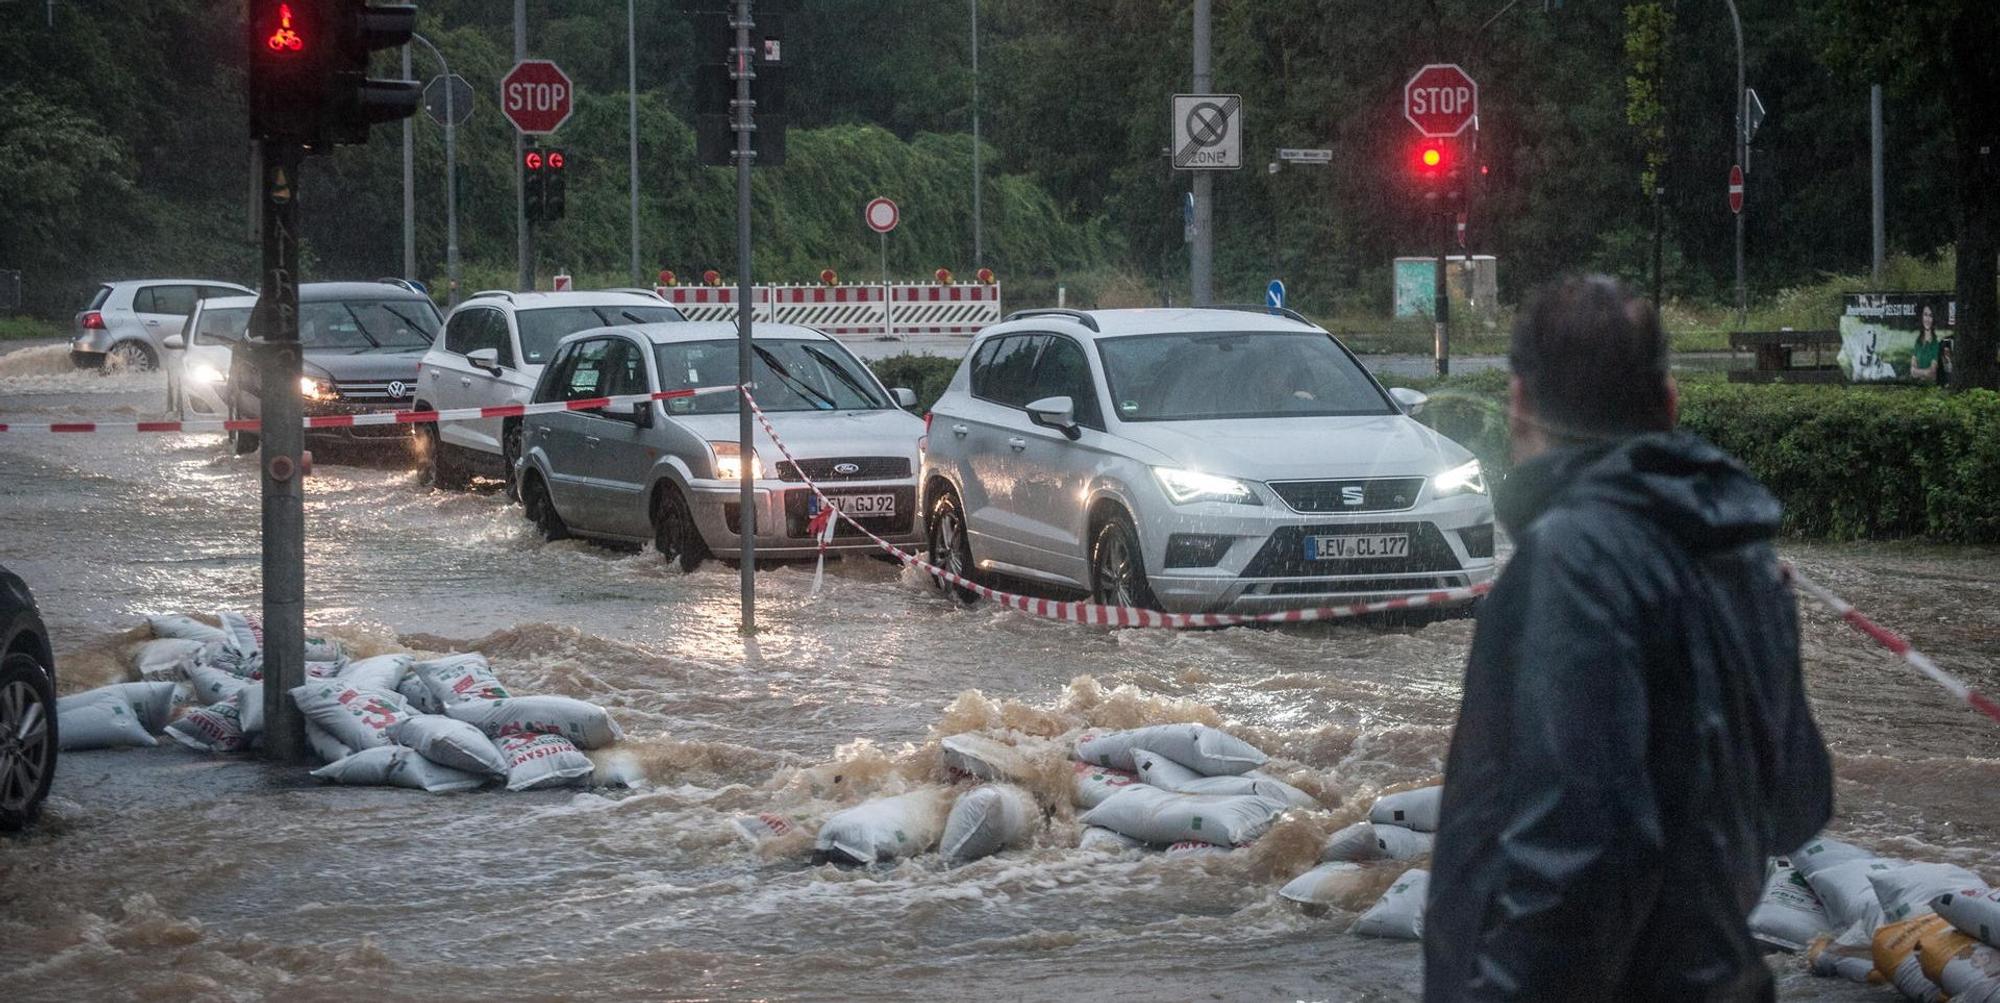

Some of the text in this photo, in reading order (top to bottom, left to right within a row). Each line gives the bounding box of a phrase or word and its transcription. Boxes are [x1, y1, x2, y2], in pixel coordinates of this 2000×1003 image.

[508, 82, 566, 112] STOP
[1413, 87, 1470, 114] STOP
[1191, 150, 1226, 164] ZONE
[855, 496, 874, 511] GJ
[876, 495, 893, 511] 92
[1316, 537, 1407, 557] LEV CL 177
